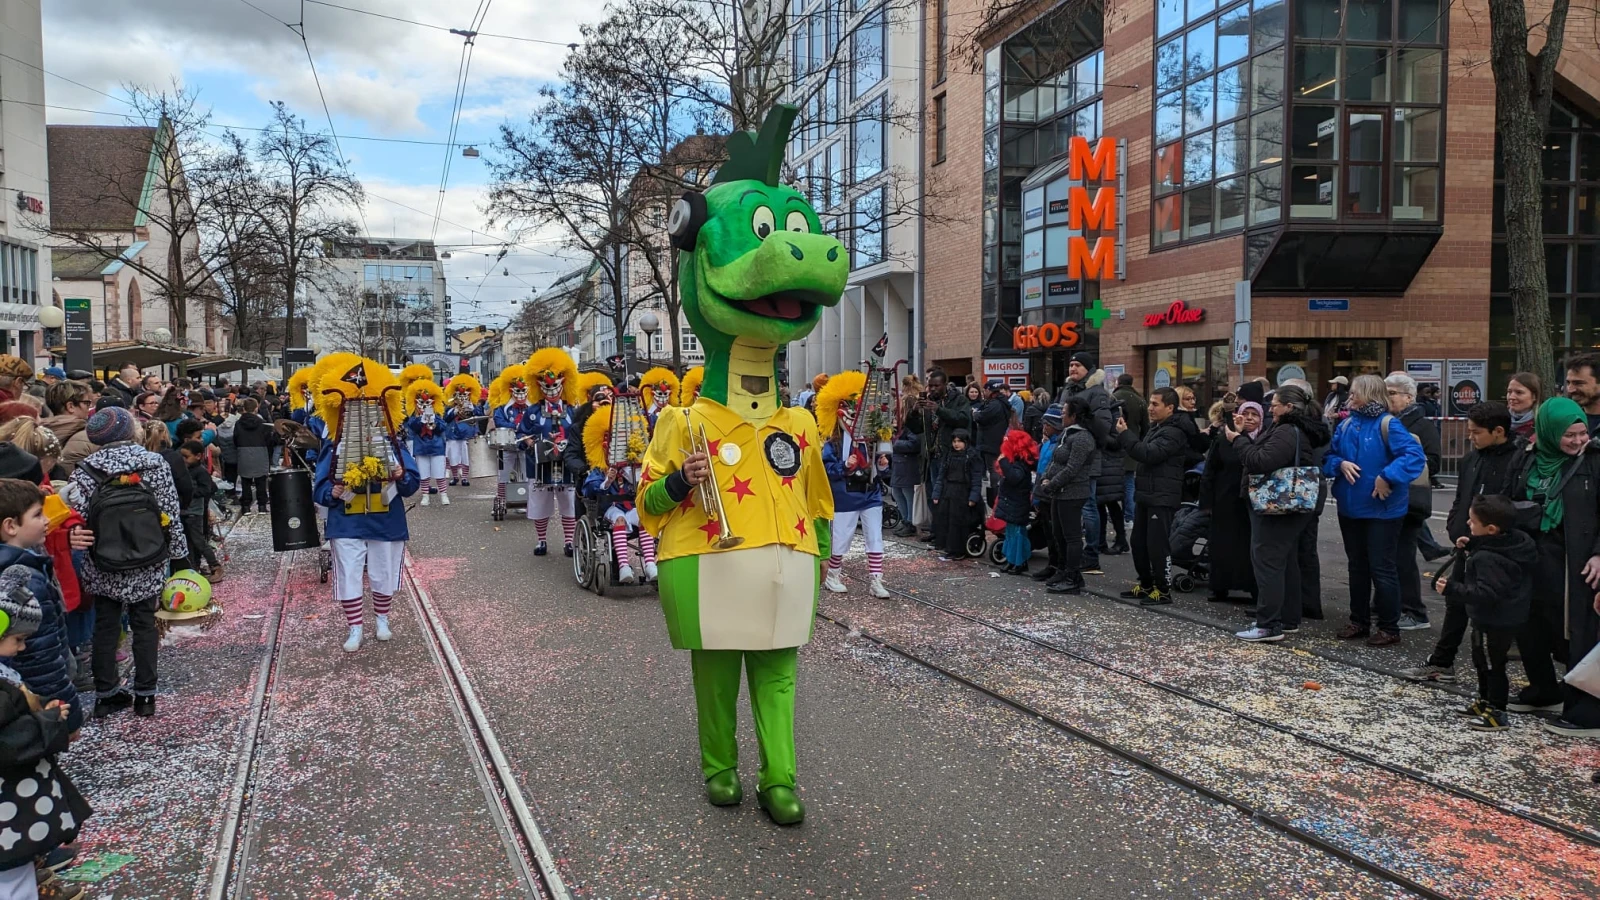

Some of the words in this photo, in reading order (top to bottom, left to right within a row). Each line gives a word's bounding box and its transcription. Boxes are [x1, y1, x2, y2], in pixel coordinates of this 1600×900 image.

[27, 196, 43, 214] UBS
[1143, 313, 1165, 327] zur
[1166, 300, 1203, 325] Rose
[988, 362, 1025, 371] MIGROS
[1453, 389, 1480, 399] outlet
